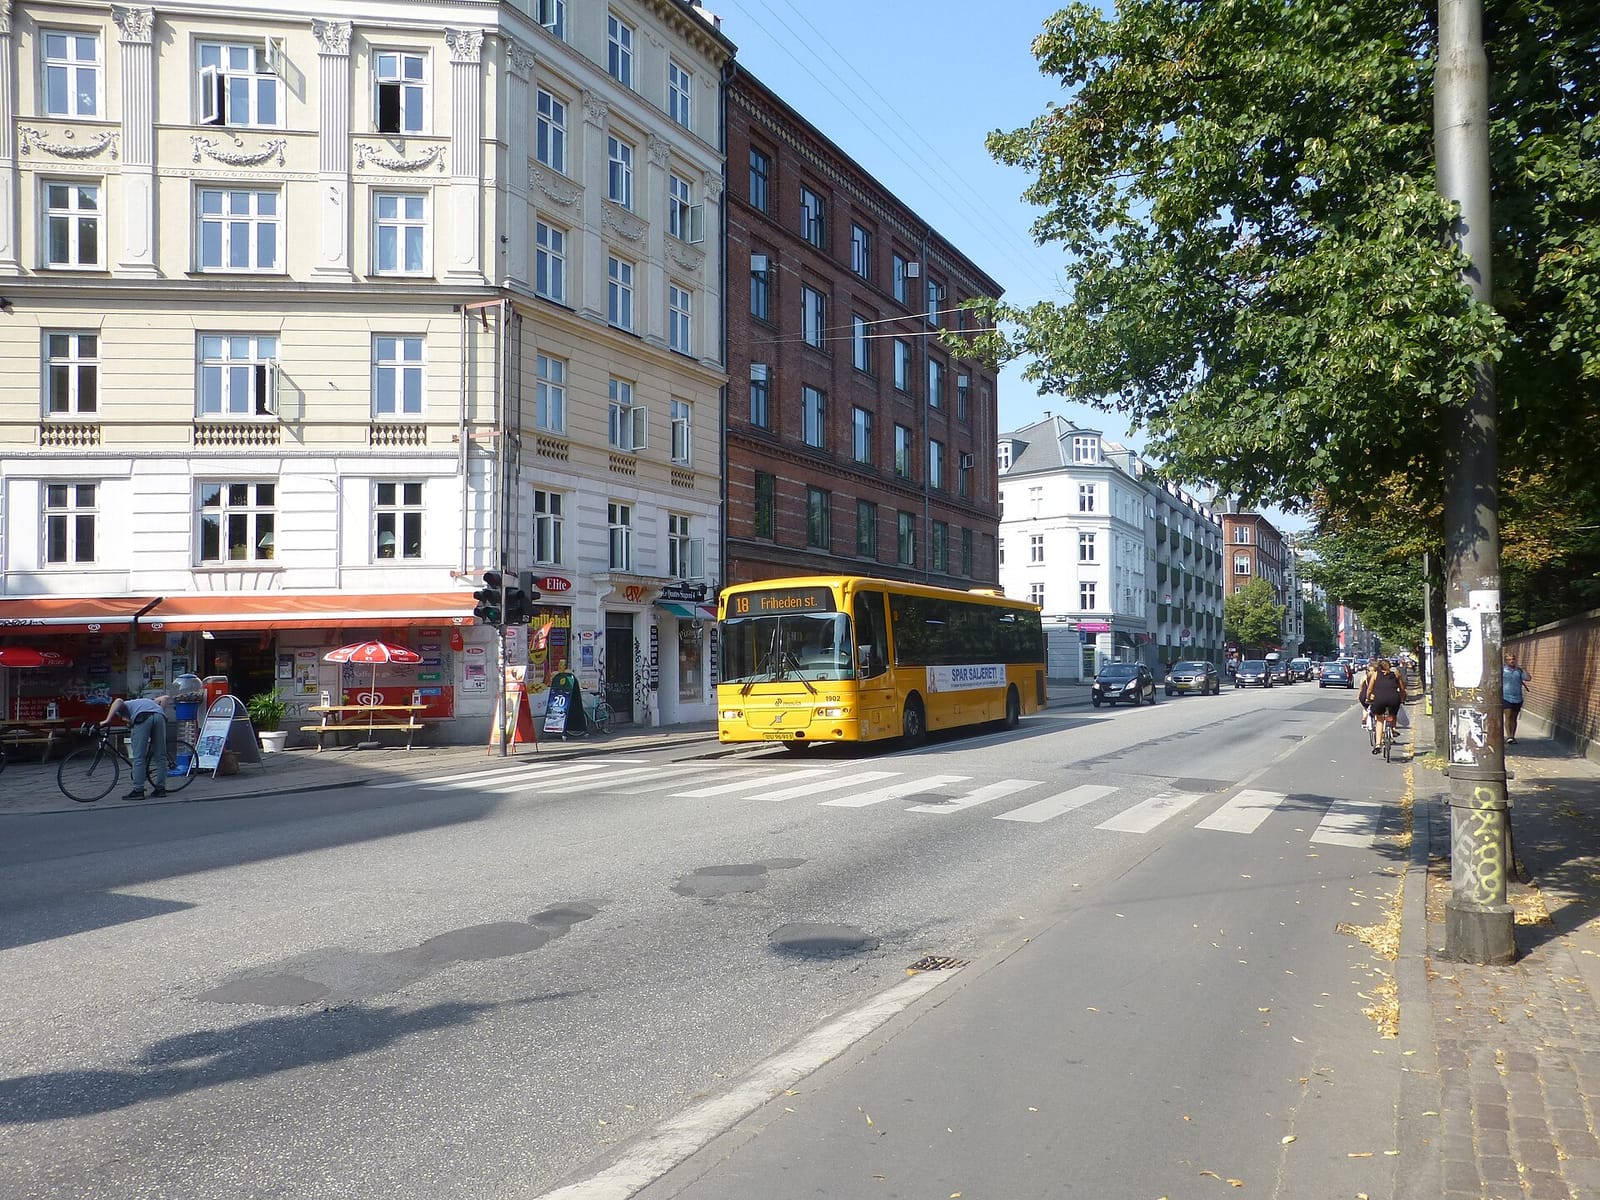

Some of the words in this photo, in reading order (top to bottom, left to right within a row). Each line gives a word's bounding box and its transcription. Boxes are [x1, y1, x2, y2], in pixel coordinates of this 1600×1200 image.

[546, 577, 567, 590] Elite
[736, 597, 749, 613] 18
[760, 596, 802, 609] Friheden
[804, 596, 818, 607] st.
[951, 668, 968, 682] SPAR
[968, 667, 997, 681] SALÆRET!
[553, 696, 566, 707] 20
